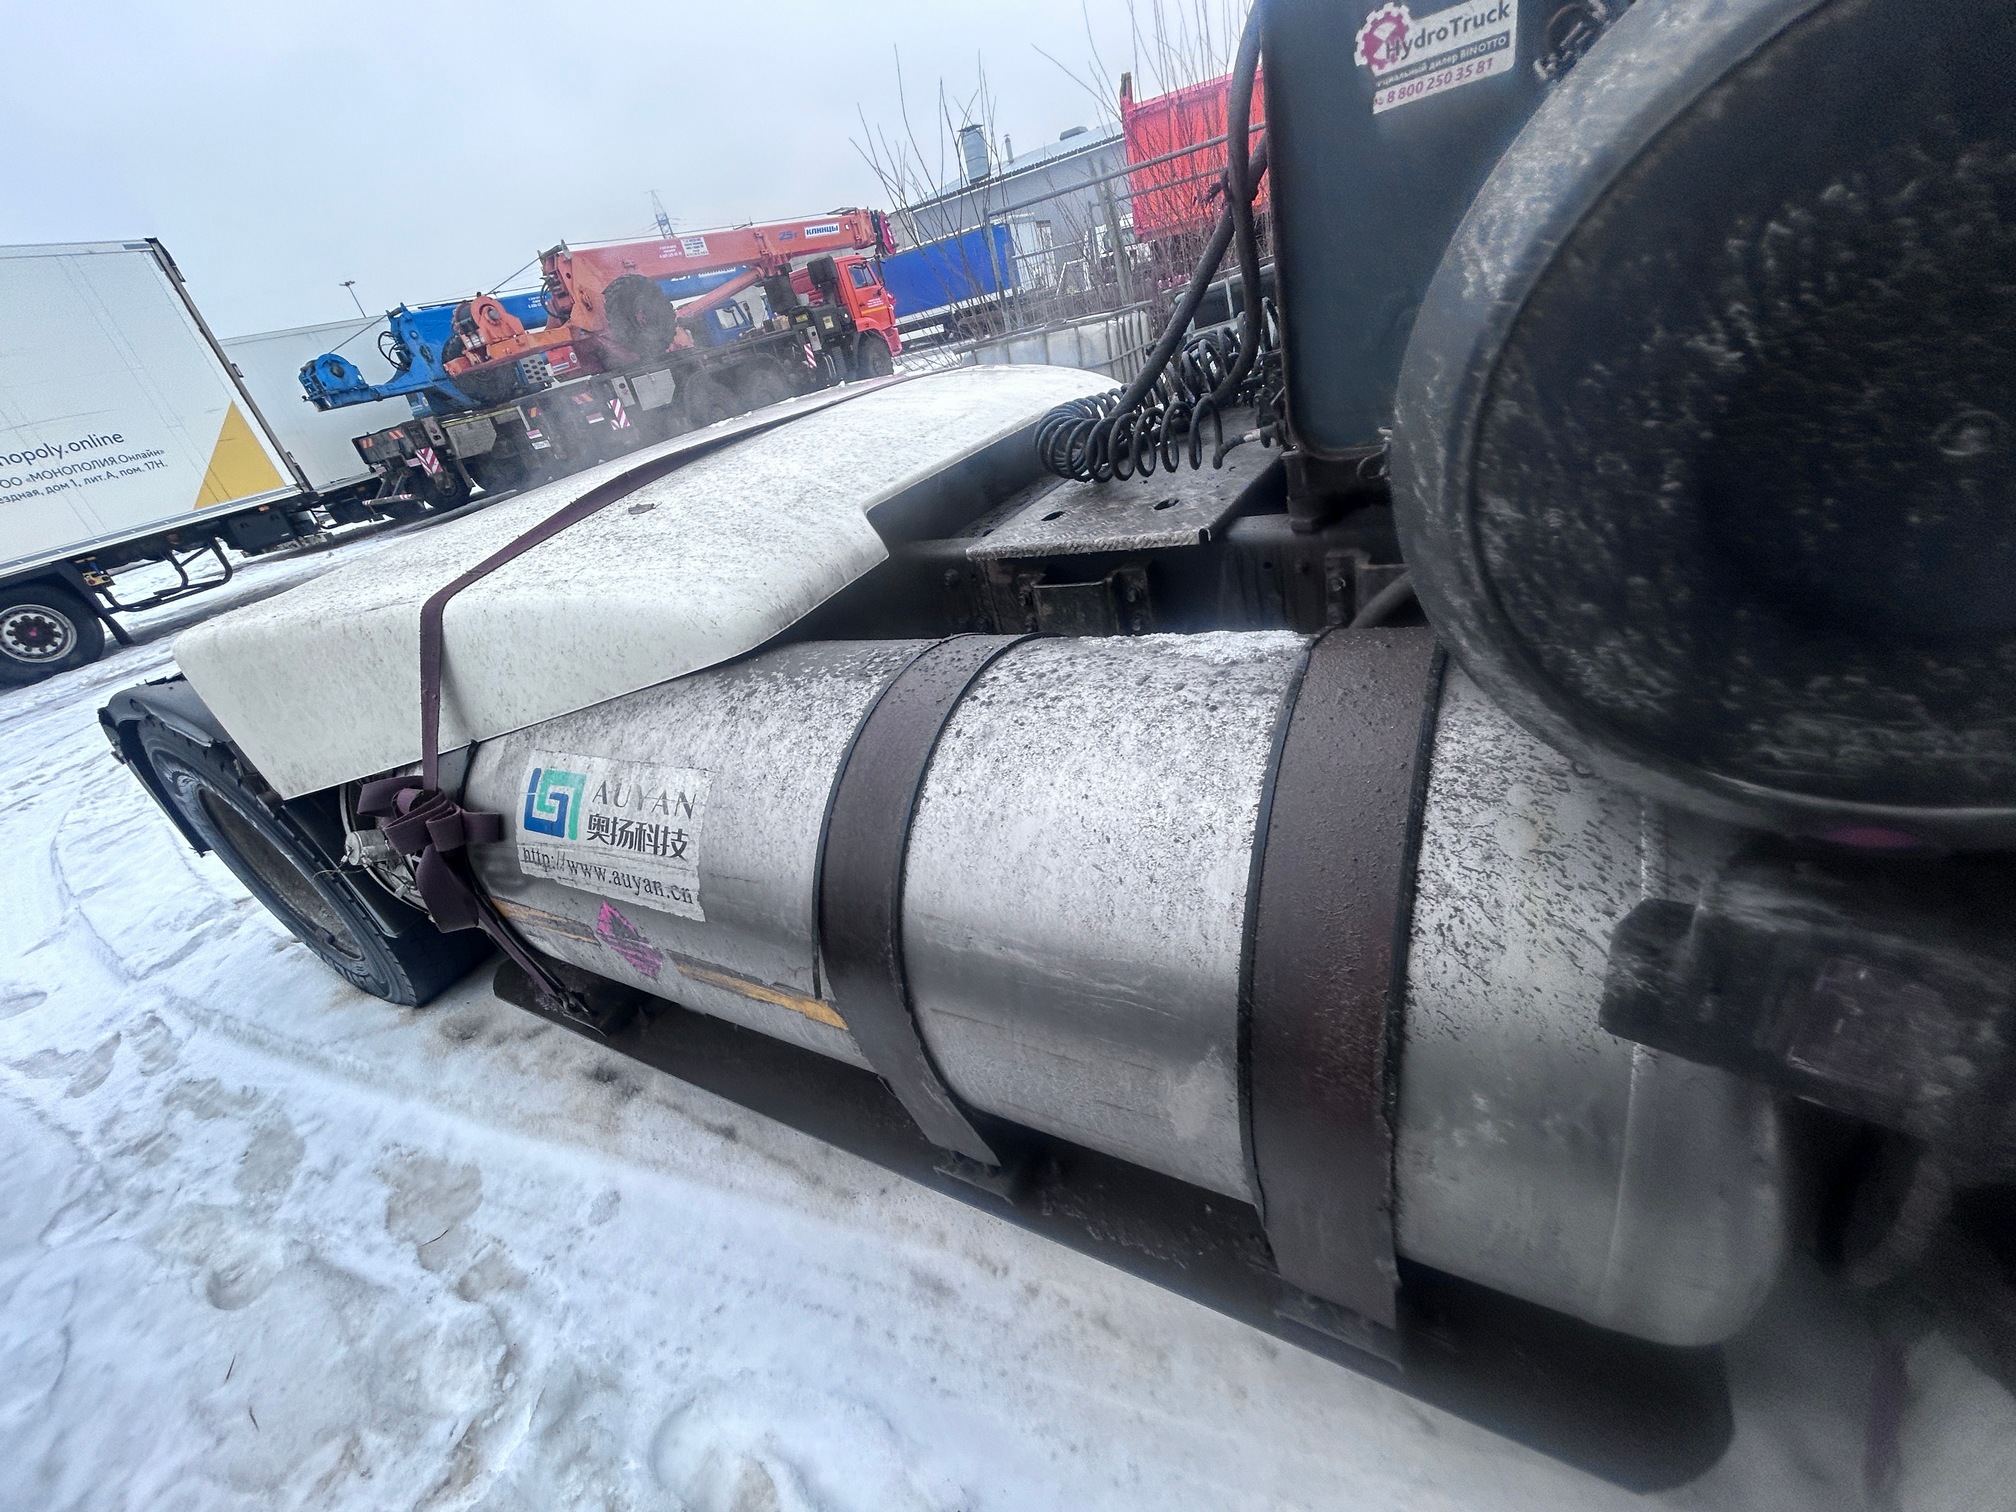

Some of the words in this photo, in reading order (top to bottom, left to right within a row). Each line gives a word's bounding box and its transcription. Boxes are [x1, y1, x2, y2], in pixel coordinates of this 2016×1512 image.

[1385, 3, 1510, 61] HydroTruck
[1459, 36, 1507, 60] BINOTTO
[1387, 90, 1395, 104] 8
[1397, 81, 1424, 100] 800
[1426, 72, 1453, 91] 250
[1455, 63, 1474, 80] 35
[1475, 57, 1493, 75] 81
[806, 225, 839, 236] КЛИНЦЫ
[0, 431, 125, 467] nopoly.online
[45, 483, 71, 495] дом
[119, 467, 146, 477] пом.
[592, 780, 697, 819] AUYAN
[586, 813, 689, 861] 奥扬科技
[522, 847, 694, 904] http://www.auyan.cn
